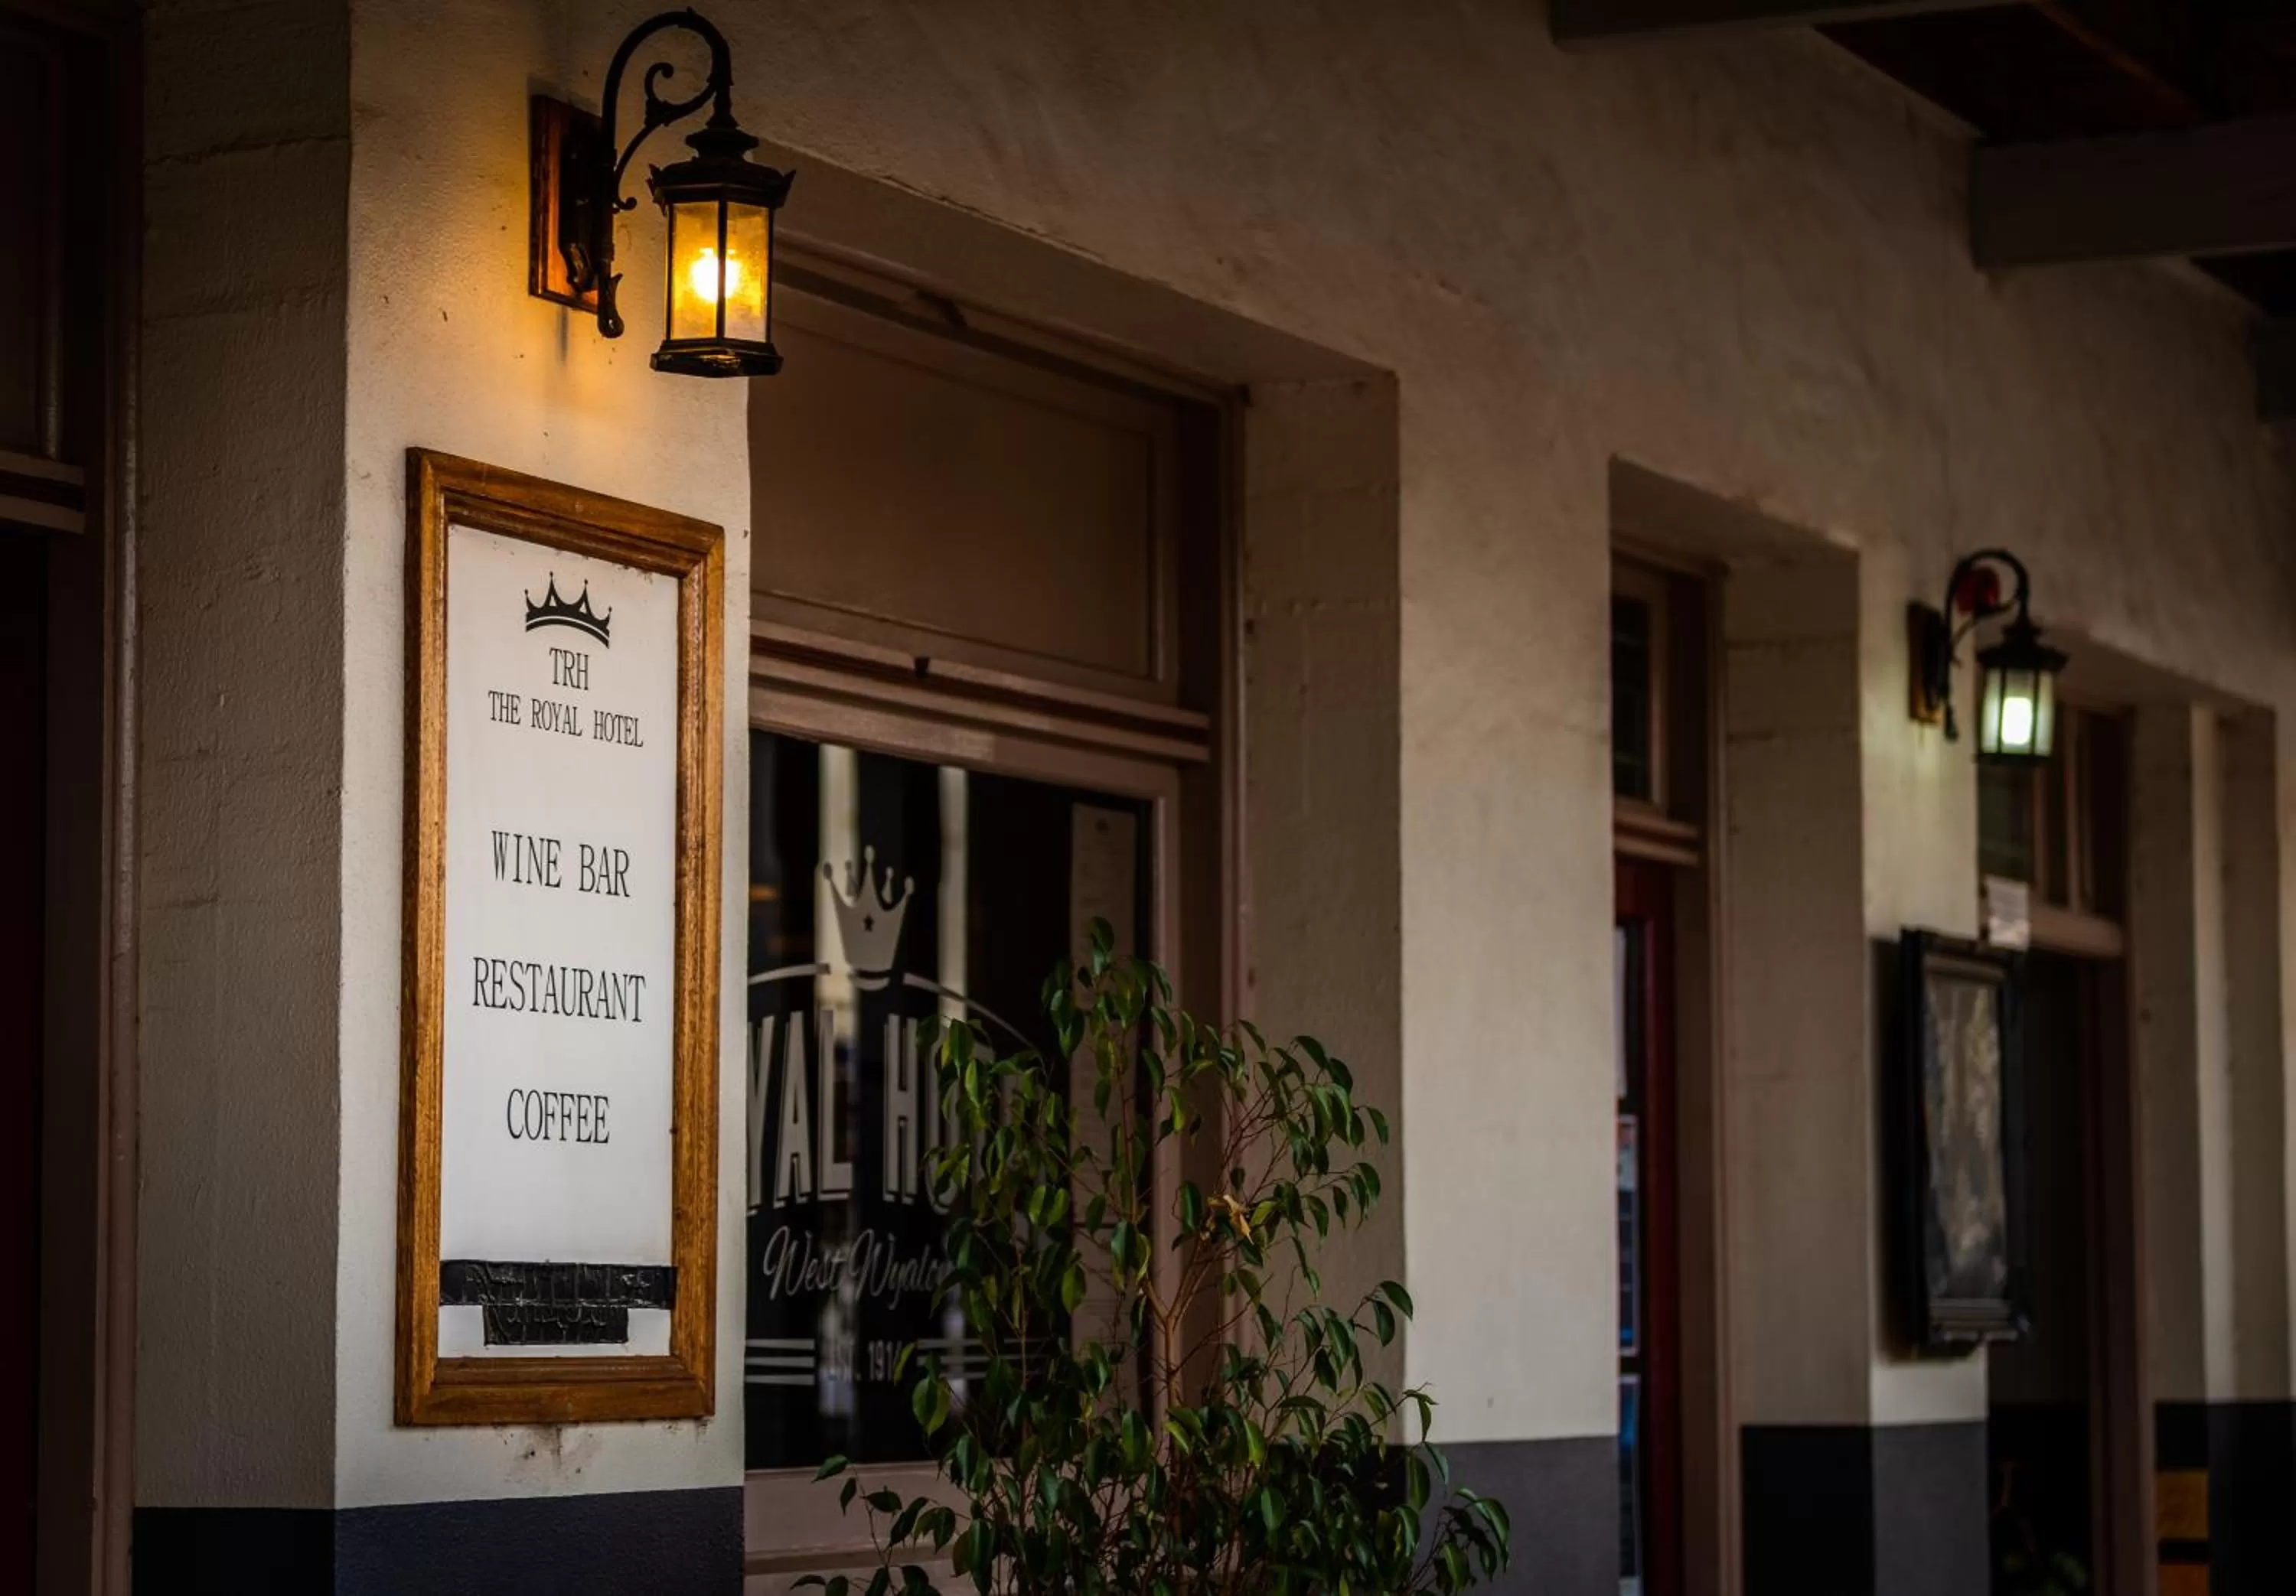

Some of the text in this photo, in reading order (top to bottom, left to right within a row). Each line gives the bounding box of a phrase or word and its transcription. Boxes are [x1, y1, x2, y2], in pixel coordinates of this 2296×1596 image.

[549, 647, 589, 691] TRH
[488, 690, 644, 748] THE ROYAL HOTEL
[491, 830, 631, 897] WINE BAR
[472, 956, 645, 1023] RESTAURANT
[507, 1089, 609, 1144] COFFEE
[763, 1225, 846, 1301] West
